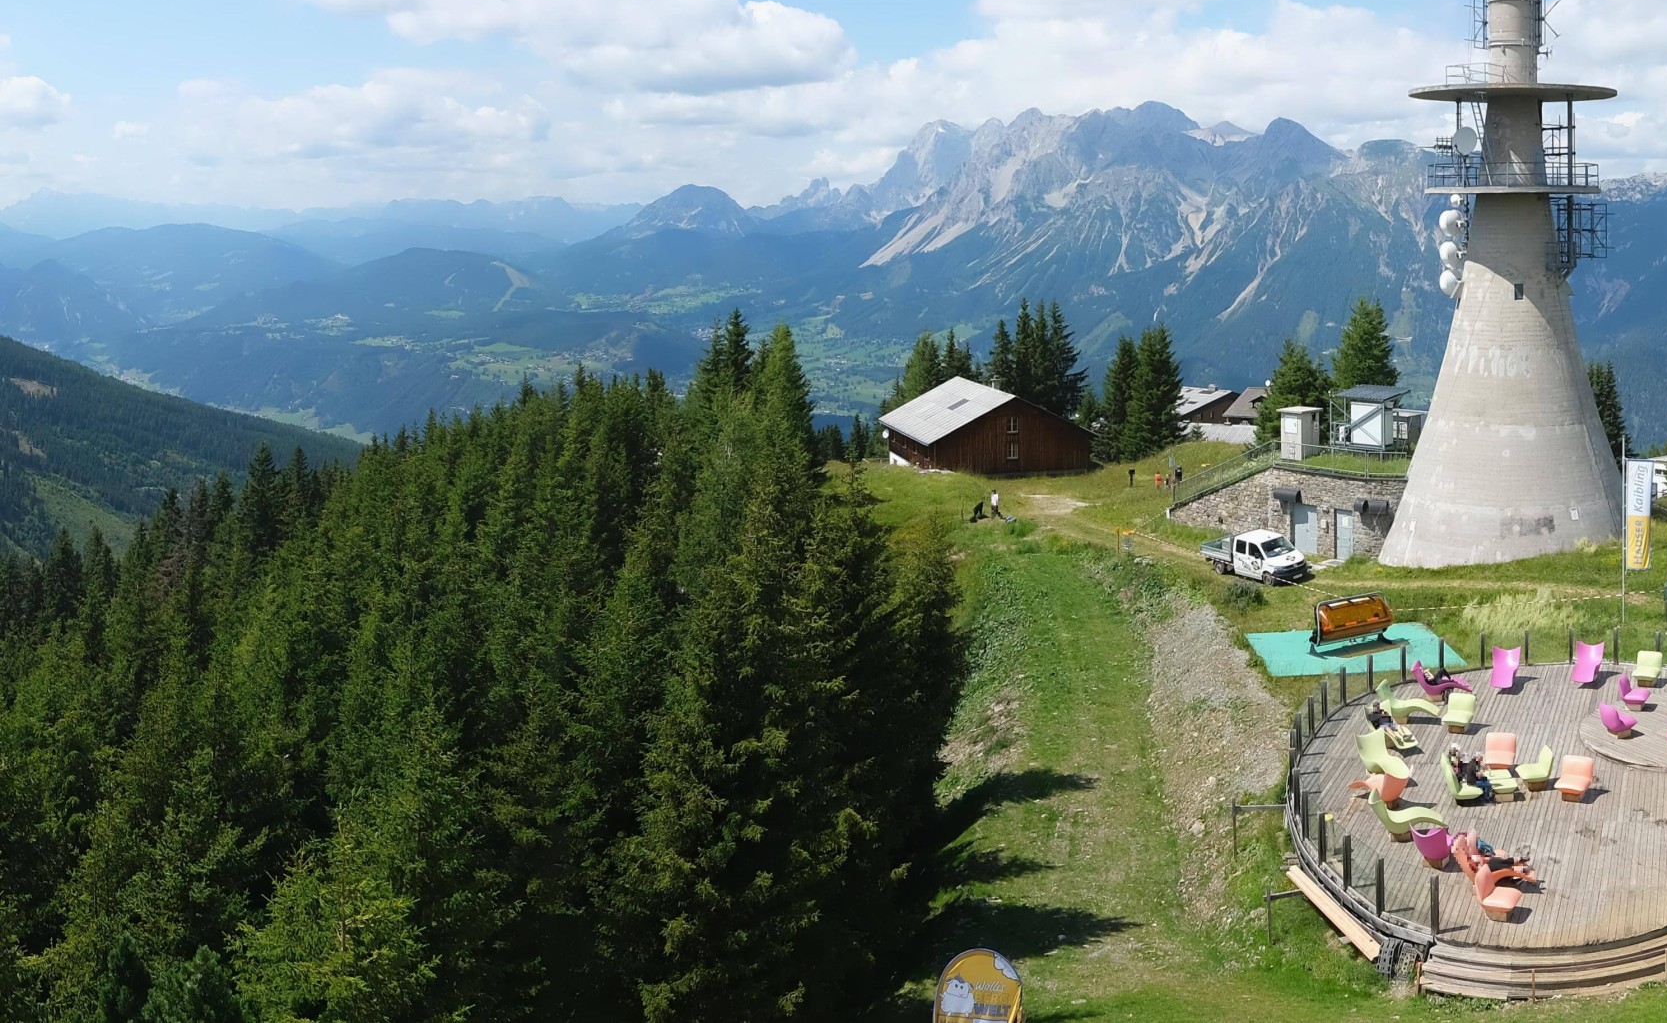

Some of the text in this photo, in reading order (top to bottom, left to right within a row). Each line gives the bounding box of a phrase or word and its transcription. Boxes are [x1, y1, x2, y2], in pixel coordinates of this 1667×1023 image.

[1633, 465, 1648, 565] HAUSER Kaibling
[975, 991, 1009, 1004] BERG
[974, 1003, 1011, 1016] WELT
